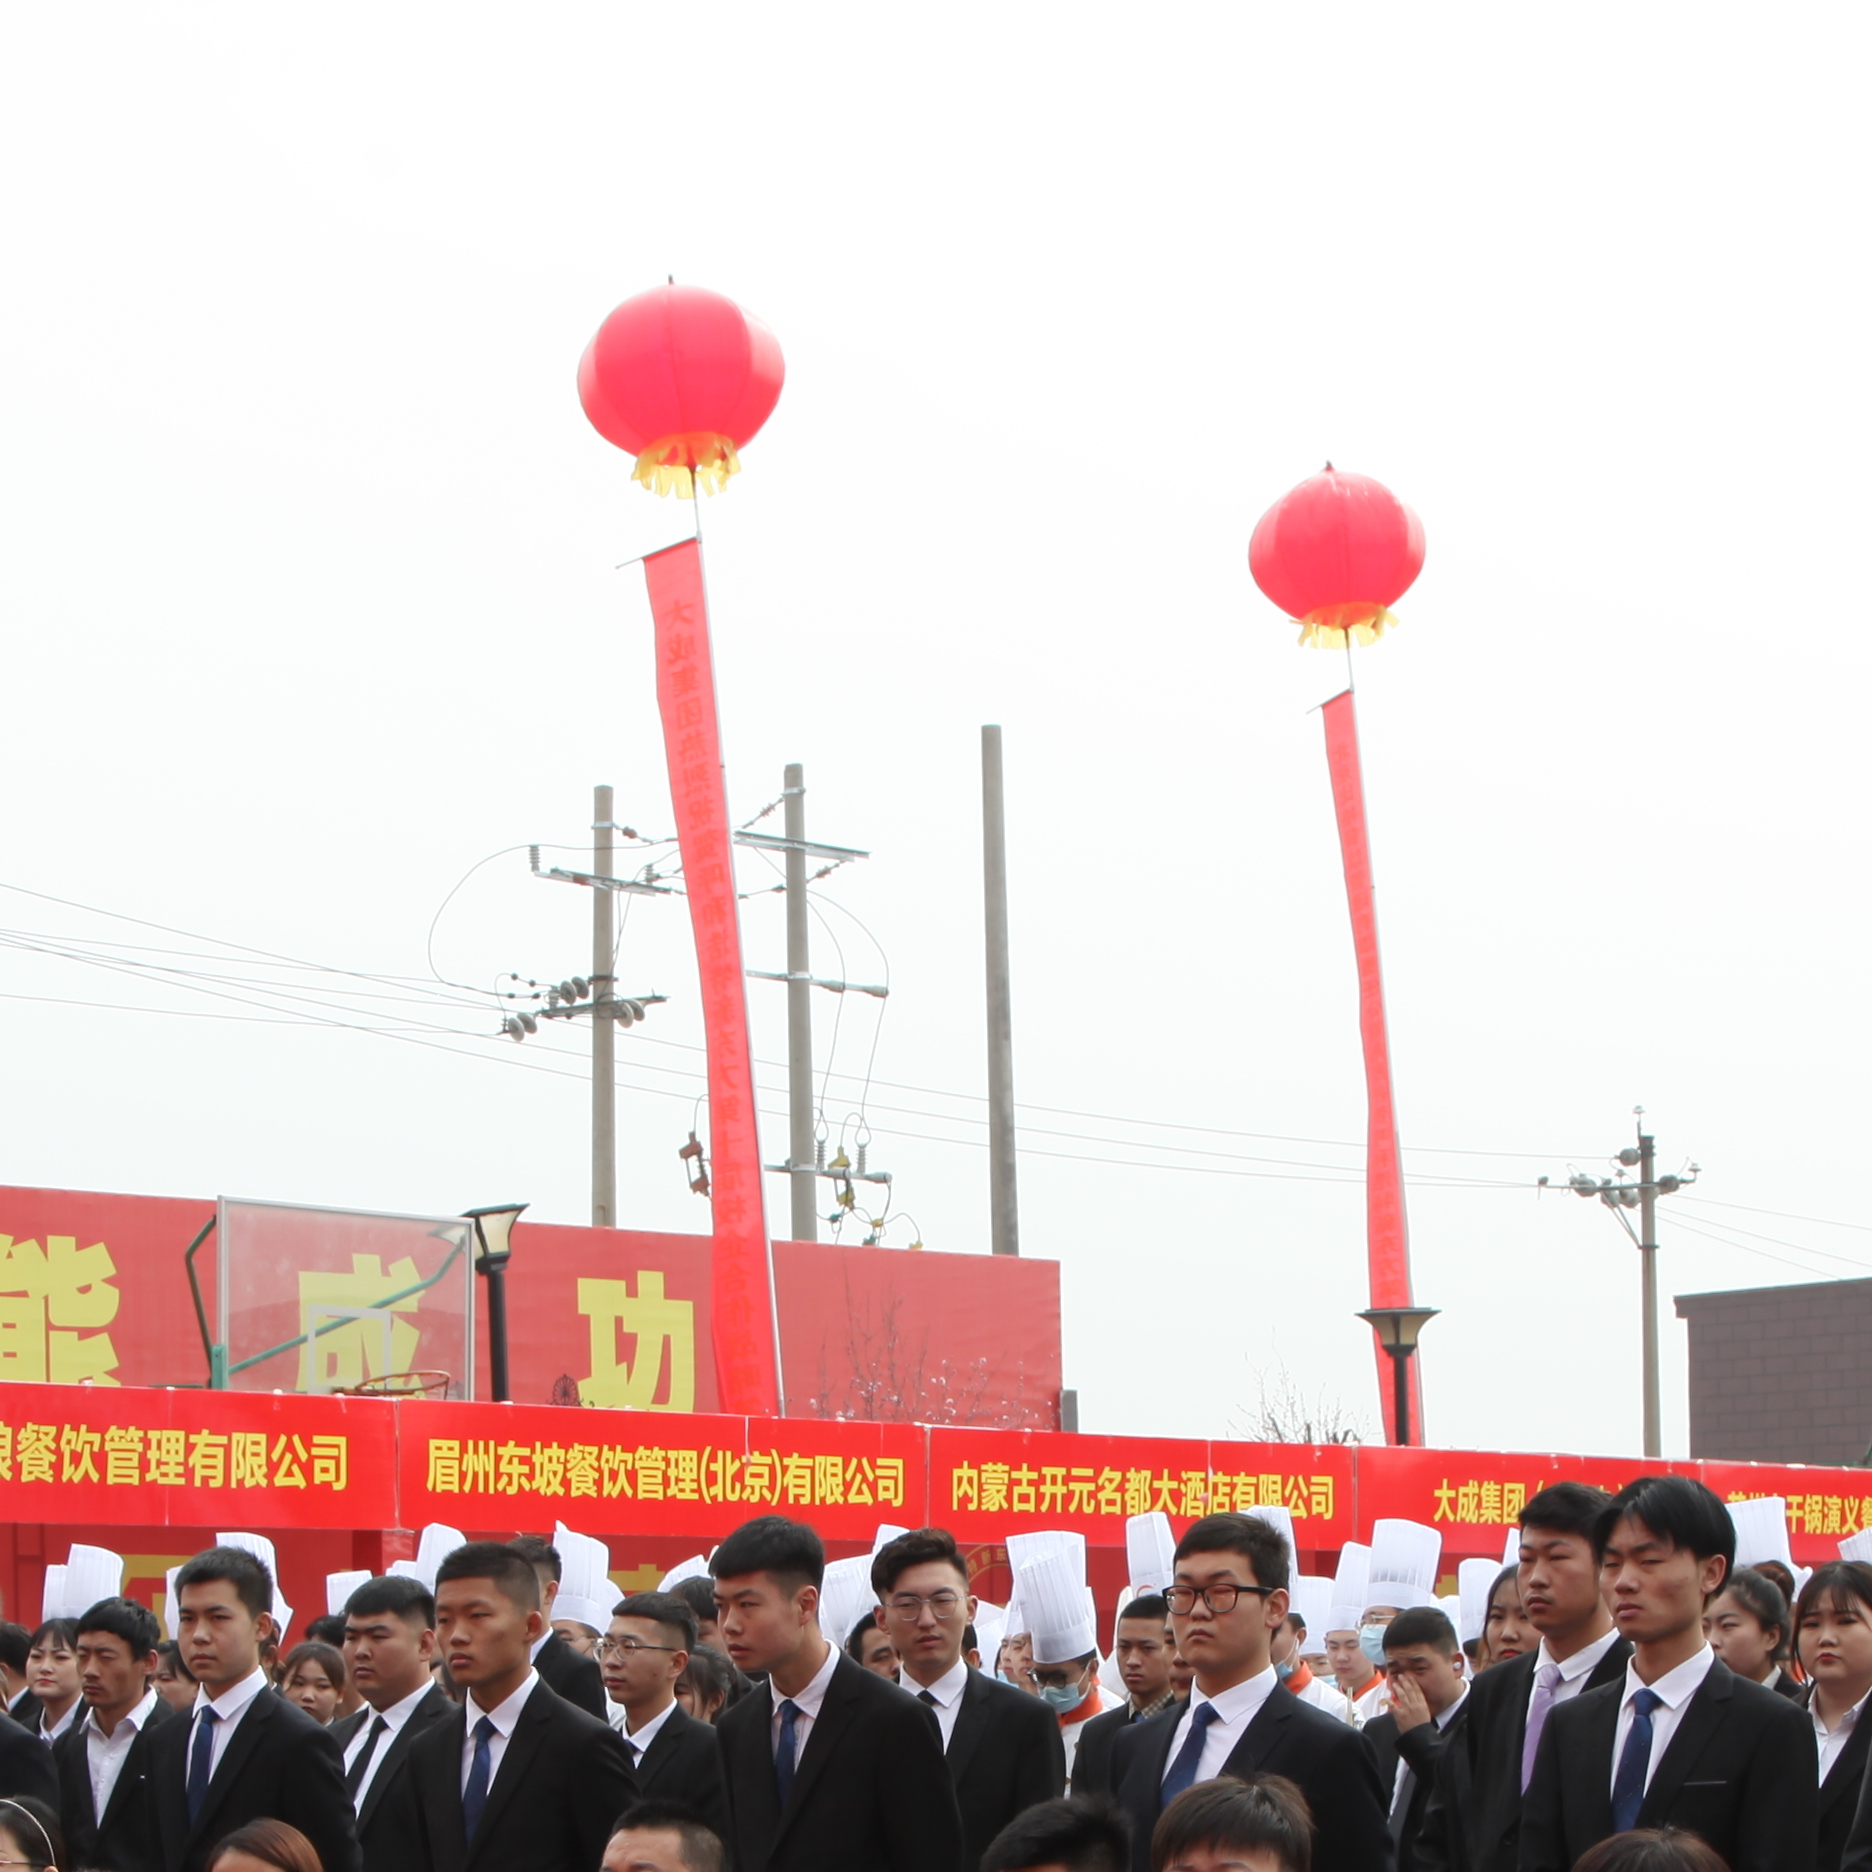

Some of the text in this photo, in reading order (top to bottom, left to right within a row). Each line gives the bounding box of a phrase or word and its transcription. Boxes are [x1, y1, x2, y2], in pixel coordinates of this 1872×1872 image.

[951, 1460, 1334, 1521] 内蒙古开元名都大酒店有限公司
